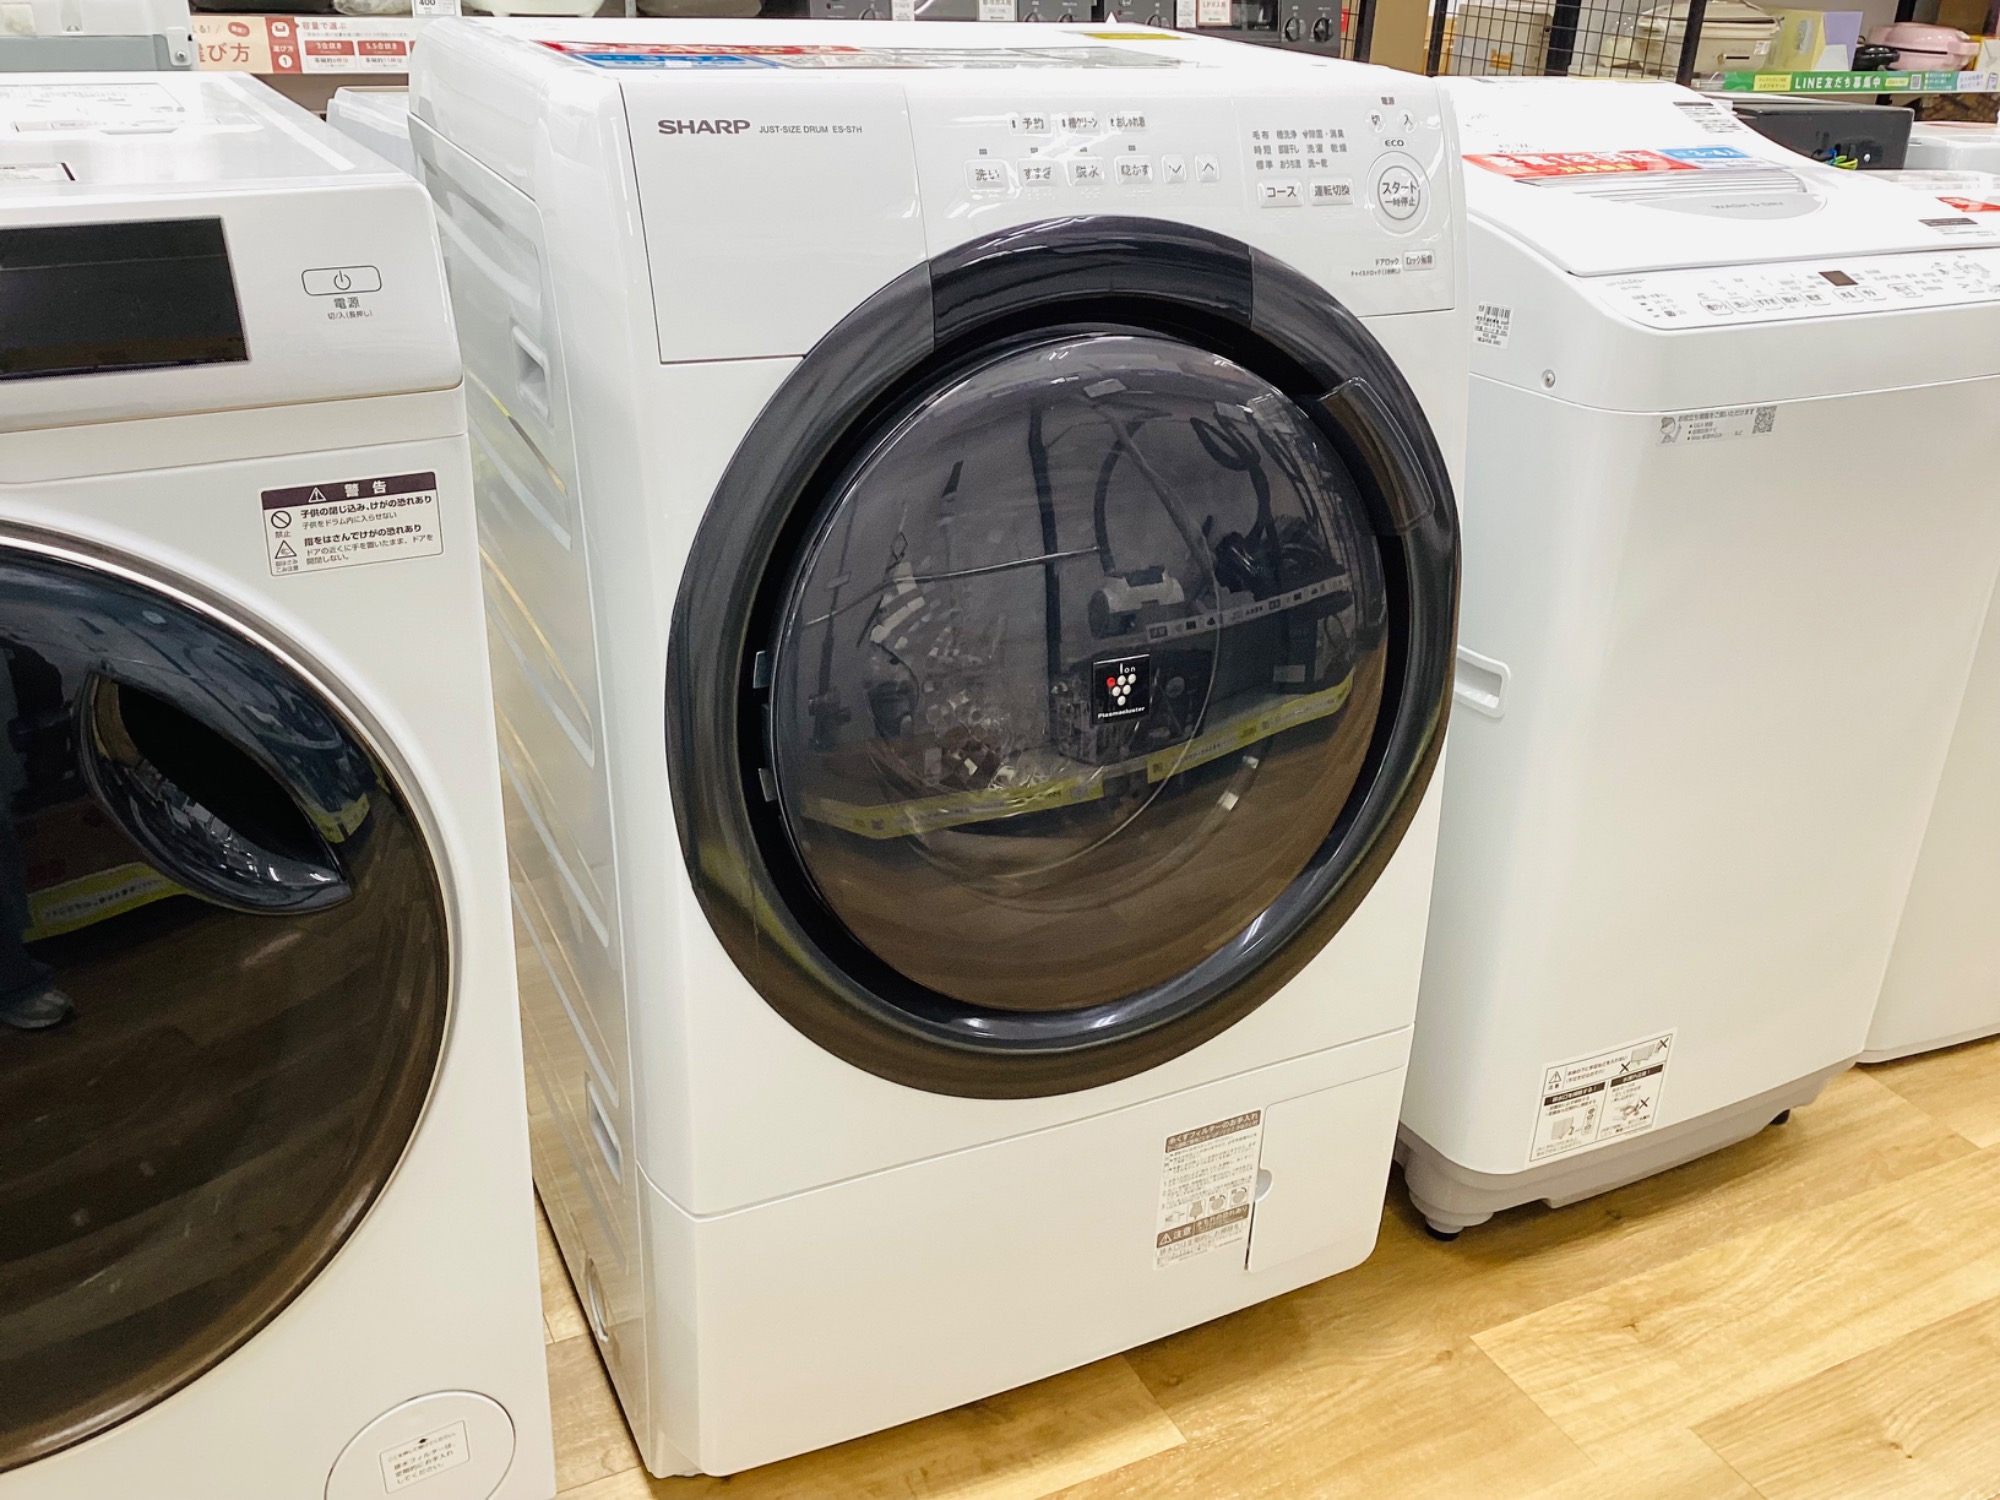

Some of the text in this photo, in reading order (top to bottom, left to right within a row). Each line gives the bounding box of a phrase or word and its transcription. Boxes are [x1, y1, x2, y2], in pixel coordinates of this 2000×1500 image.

[1794, 76, 1881, 89] LINE友だち募集中
[657, 119, 751, 135] SHARP
[803, 125, 829, 134] DRUM
[832, 125, 863, 134] ES-S7H
[1022, 117, 1044, 130] 予約
[1384, 139, 1405, 147] ECO
[975, 168, 1000, 181] 洗い
[1023, 166, 1052, 180] すすぎ
[1075, 165, 1100, 178] 脱水
[1266, 184, 1350, 198] コース 運転切換
[1382, 181, 1418, 195] スタート
[1384, 196, 1416, 208] 一時停止
[1375, 257, 1400, 267] ドアロック
[333, 296, 360, 310] 電源
[344, 479, 387, 498] 警告
[302, 511, 398, 530] 子供をドラム内に入らせない
[1119, 662, 1136, 674] Ion
[1097, 706, 1146, 719] Plasmacluster
